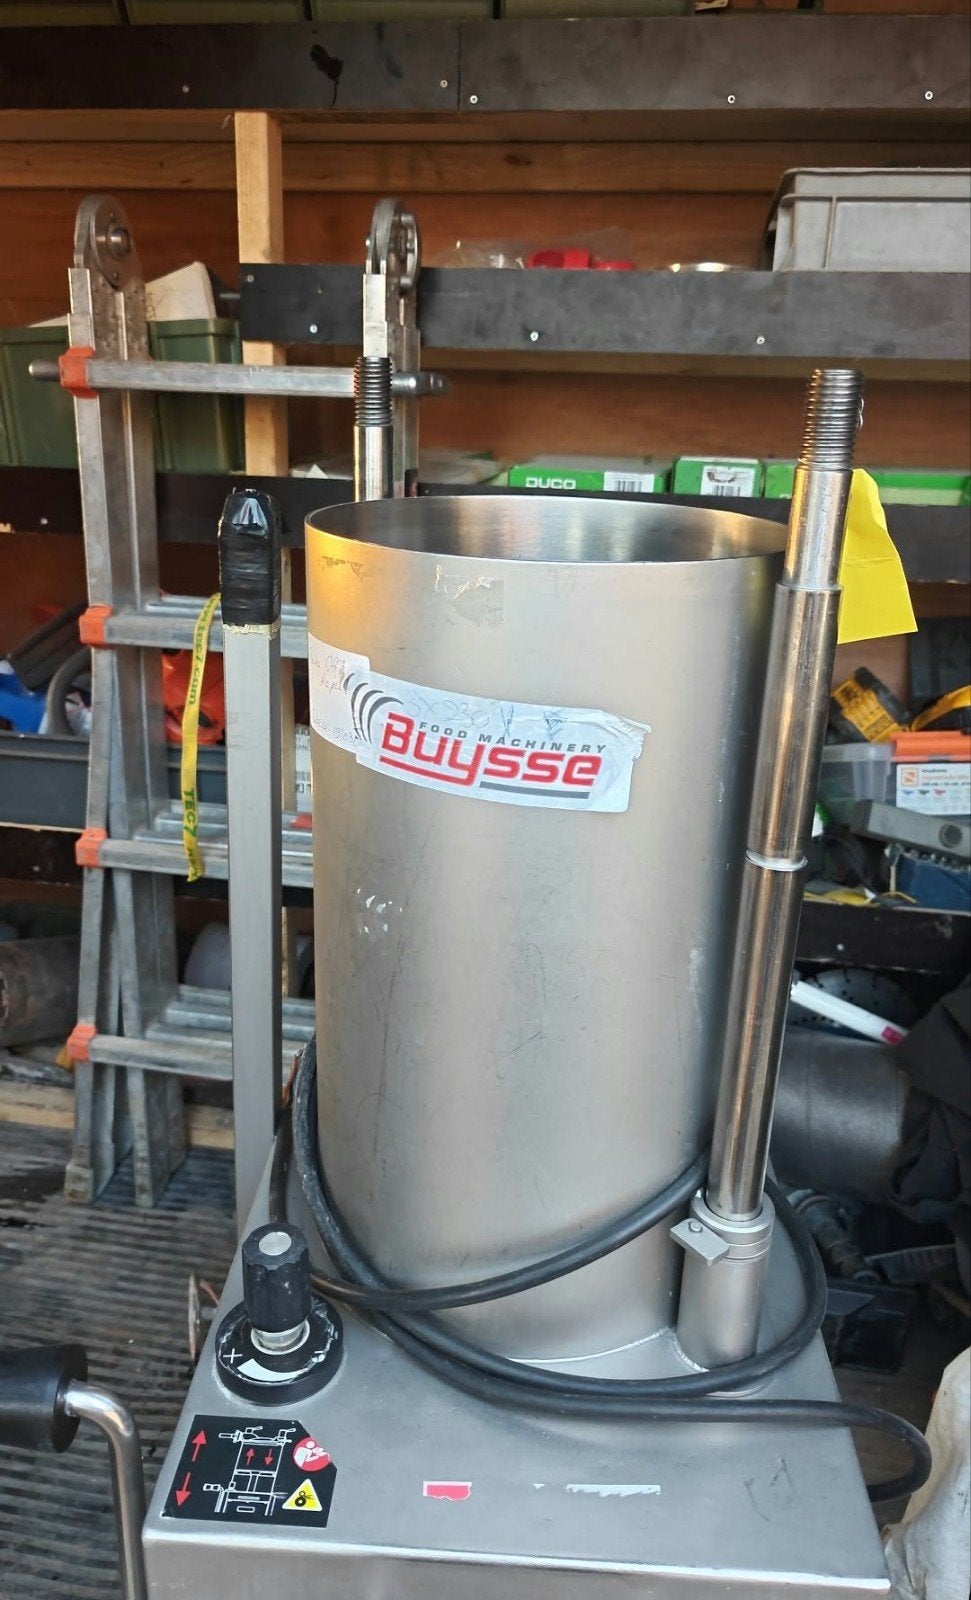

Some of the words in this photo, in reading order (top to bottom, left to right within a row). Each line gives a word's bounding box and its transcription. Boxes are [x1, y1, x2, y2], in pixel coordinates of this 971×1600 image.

[525, 476, 577, 490] DUCO
[381, 711, 603, 787] Buysse
[418, 721, 468, 739] FOOD
[478, 732, 608, 754] MACHINERY
[183, 790, 198, 838] TEC7
